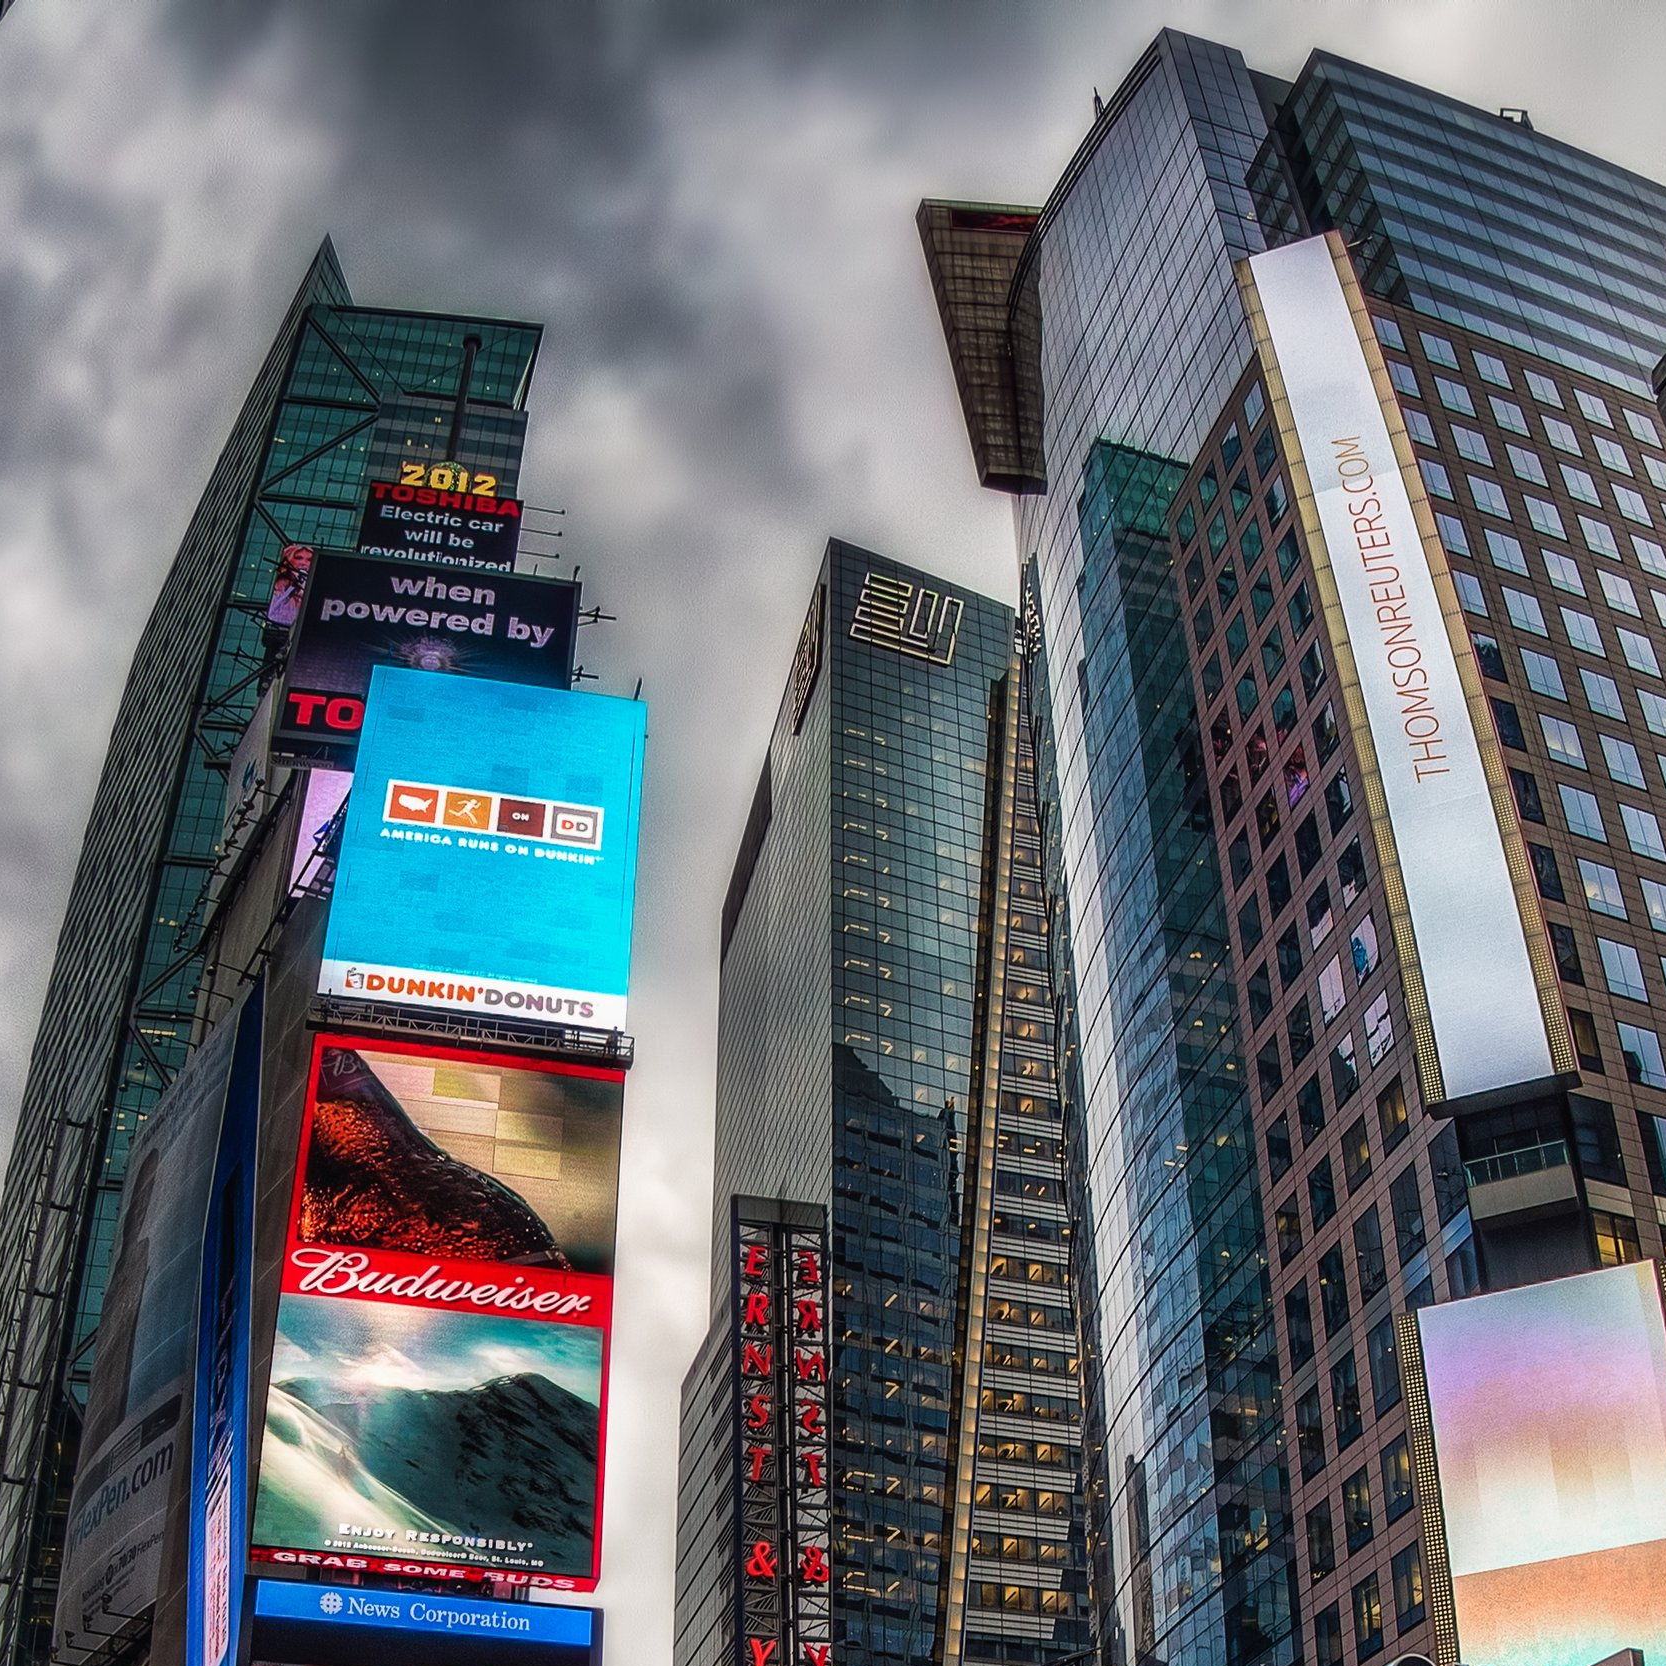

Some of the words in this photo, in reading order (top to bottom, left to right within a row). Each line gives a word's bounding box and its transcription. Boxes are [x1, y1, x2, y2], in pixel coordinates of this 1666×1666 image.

[400, 461, 498, 497] 2012
[370, 481, 520, 518] TOSHIBA
[380, 505, 462, 528] Electric
[468, 519, 504, 534] car
[404, 528, 442, 545] will
[449, 533, 475, 549] be
[360, 545, 511, 573] revolutionized
[390, 575, 496, 606] when
[321, 597, 495, 638] powered
[508, 617, 555, 649] by
[1331, 436, 1449, 783] THOMSONREUTERS.COM
[511, 811, 530, 823] ON
[380, 828, 452, 846] AMERICA
[458, 838, 499, 852] RUNS
[505, 844, 528, 856] ON
[366, 974, 484, 1003] DUNKIN'
[484, 989, 594, 1018] DONUTS
[291, 1247, 592, 1316] Budweiser
[741, 1243, 773, 1485] ERNST
[339, 1523, 395, 1540] ENJOY
[274, 1551, 367, 1569] GRAB
[383, 1563, 465, 1579] SOME
[484, 1571, 576, 1590] BUDS
[745, 1540, 777, 1580] &
[348, 1596, 400, 1619] News
[410, 1602, 530, 1632] Corporation
